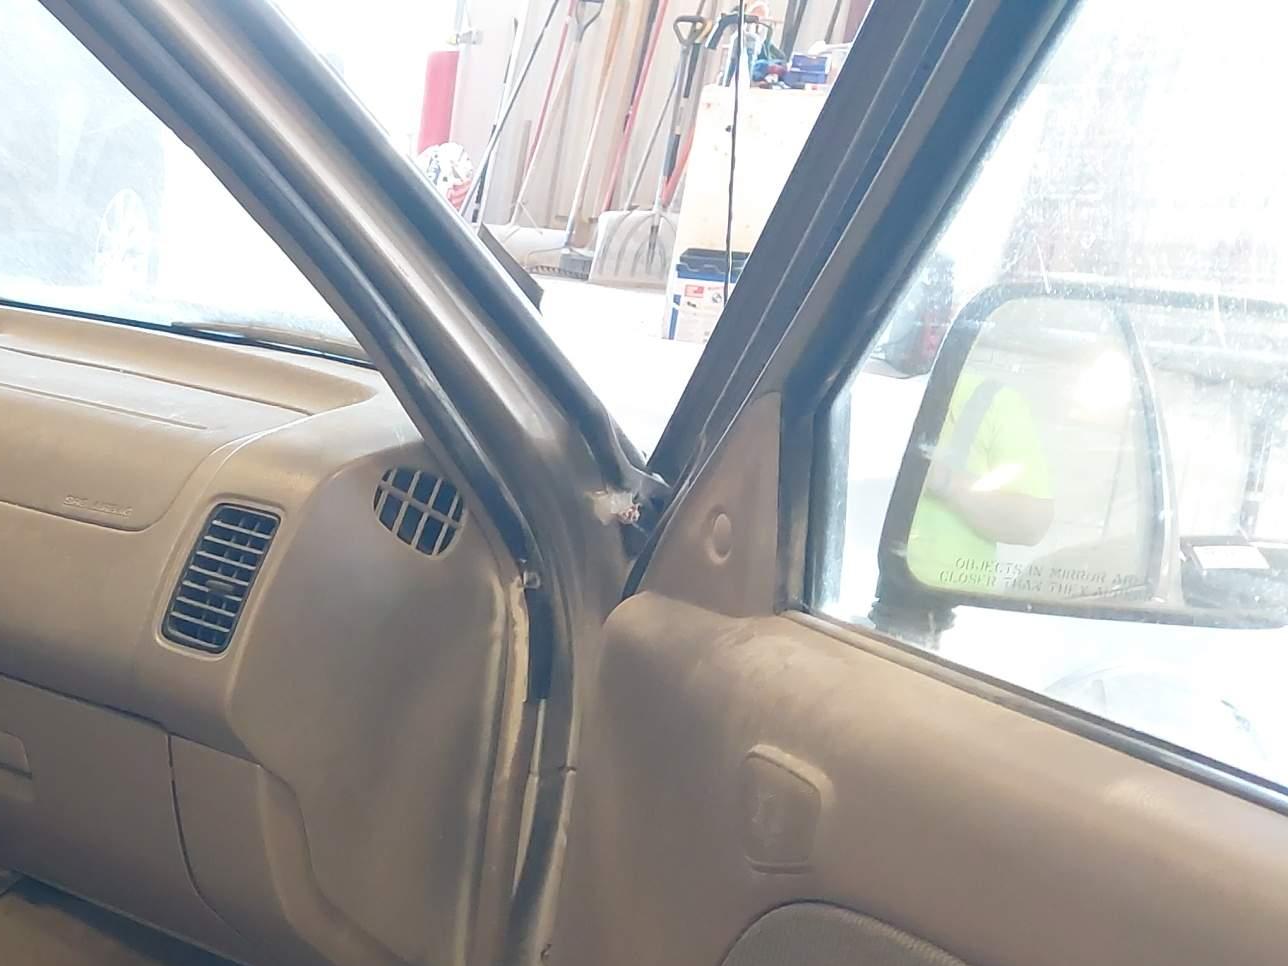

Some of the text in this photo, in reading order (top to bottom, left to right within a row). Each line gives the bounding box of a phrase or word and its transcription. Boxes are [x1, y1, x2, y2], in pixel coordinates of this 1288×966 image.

[955, 557, 1023, 576] OBJECTS
[1028, 563, 1042, 577] IN
[939, 570, 997, 587] CLOSER
